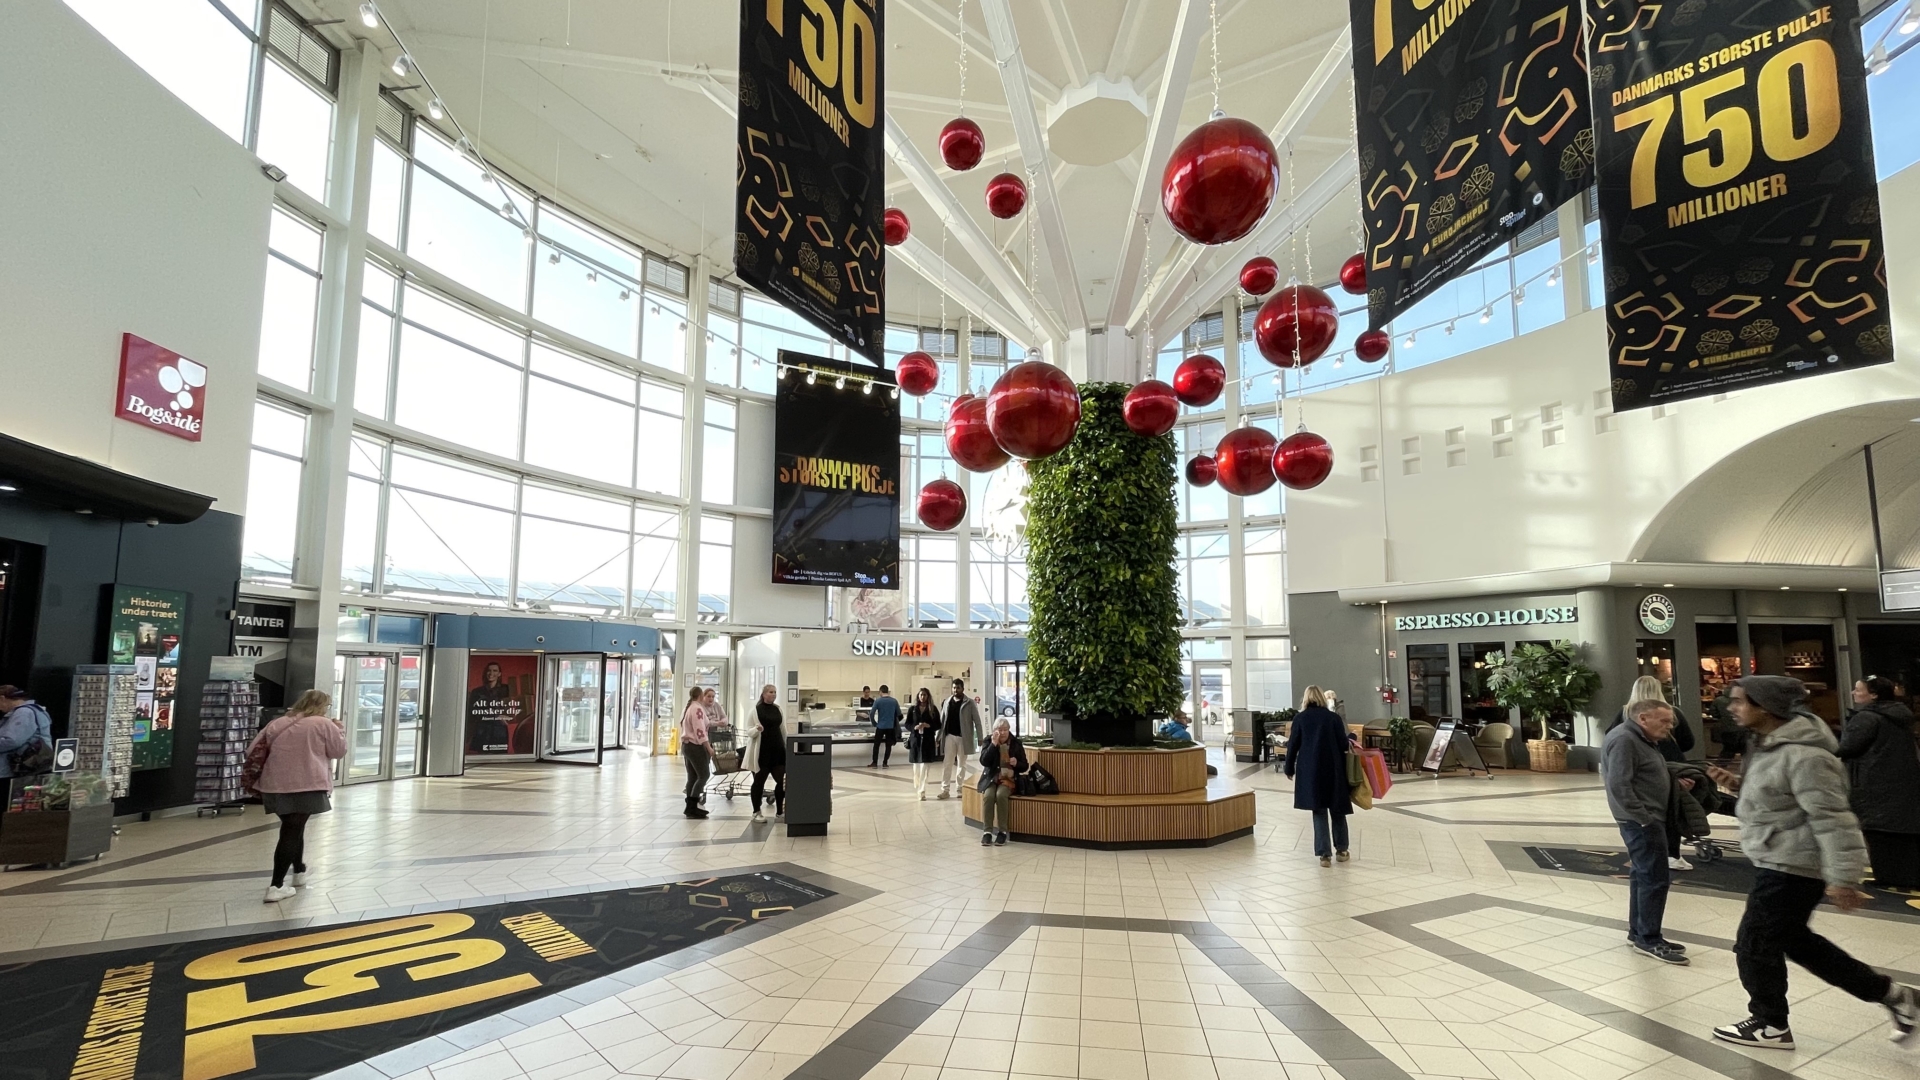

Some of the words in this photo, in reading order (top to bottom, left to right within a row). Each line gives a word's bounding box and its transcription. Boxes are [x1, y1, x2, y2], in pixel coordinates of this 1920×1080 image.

[1612, 63, 1695, 107] DANMARKS
[1699, 31, 1773, 73] STØRSTE
[1776, 5, 1833, 43] PULJE
[788, 57, 850, 148] MILLIONER
[1614, 38, 1842, 210] 750
[1667, 173, 1788, 229] MILLIONER
[1431, 198, 1490, 250] EUROJACKPOT
[126, 394, 201, 434] Bog&idé
[121, 607, 150, 617] under
[151, 609, 178, 619] træet
[131, 597, 172, 609] Historier
[1395, 611, 1490, 631] ESPRESSO
[1494, 606, 1577, 626] HOUSE
[1643, 596, 1673, 612] ESPRESSO
[1647, 621, 1671, 632] HOUSE
[473, 700, 487, 708] Alt
[500, 911, 598, 962] MILLIONER
[98, 961, 155, 994] PULJE
[183, 912, 543, 1080] 750
